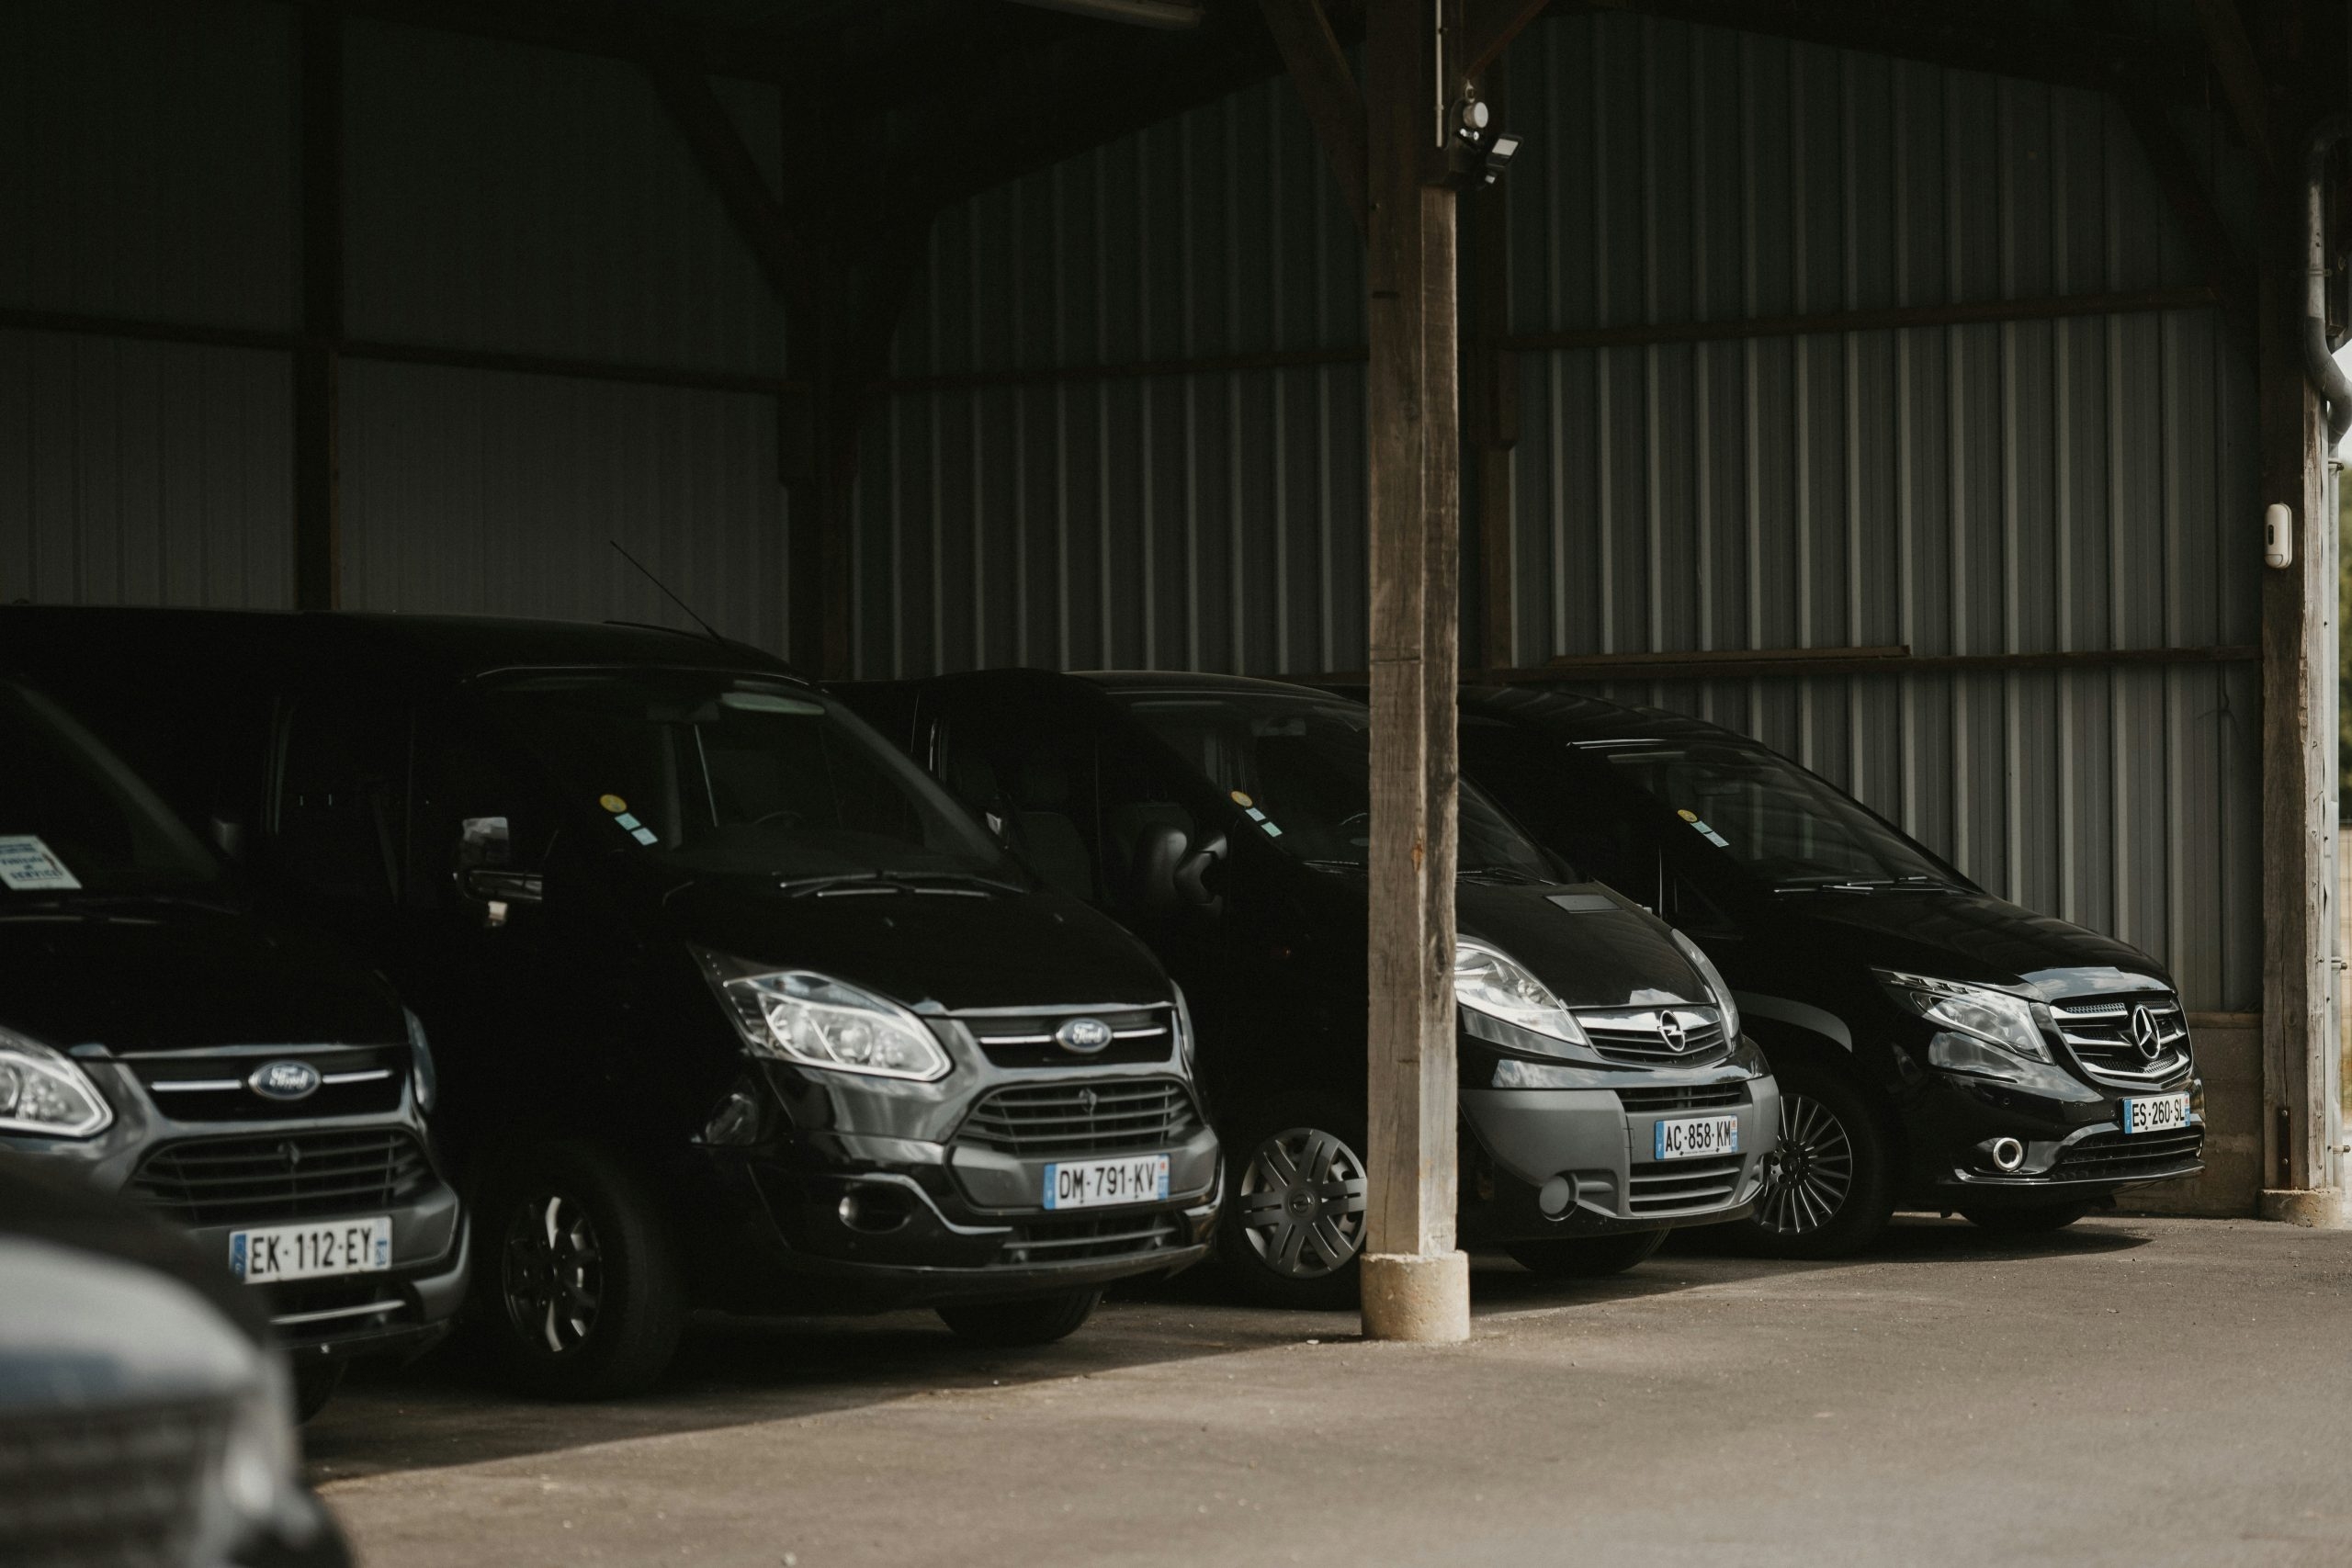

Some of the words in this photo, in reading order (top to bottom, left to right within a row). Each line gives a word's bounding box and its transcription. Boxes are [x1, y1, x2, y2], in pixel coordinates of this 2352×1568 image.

[1073, 1023, 1102, 1044] Ford
[1666, 1121, 1731, 1152] AC-858-KM
[1059, 1163, 1156, 1199] DM-791-KV
[250, 1227, 372, 1274] EK-112-EY
